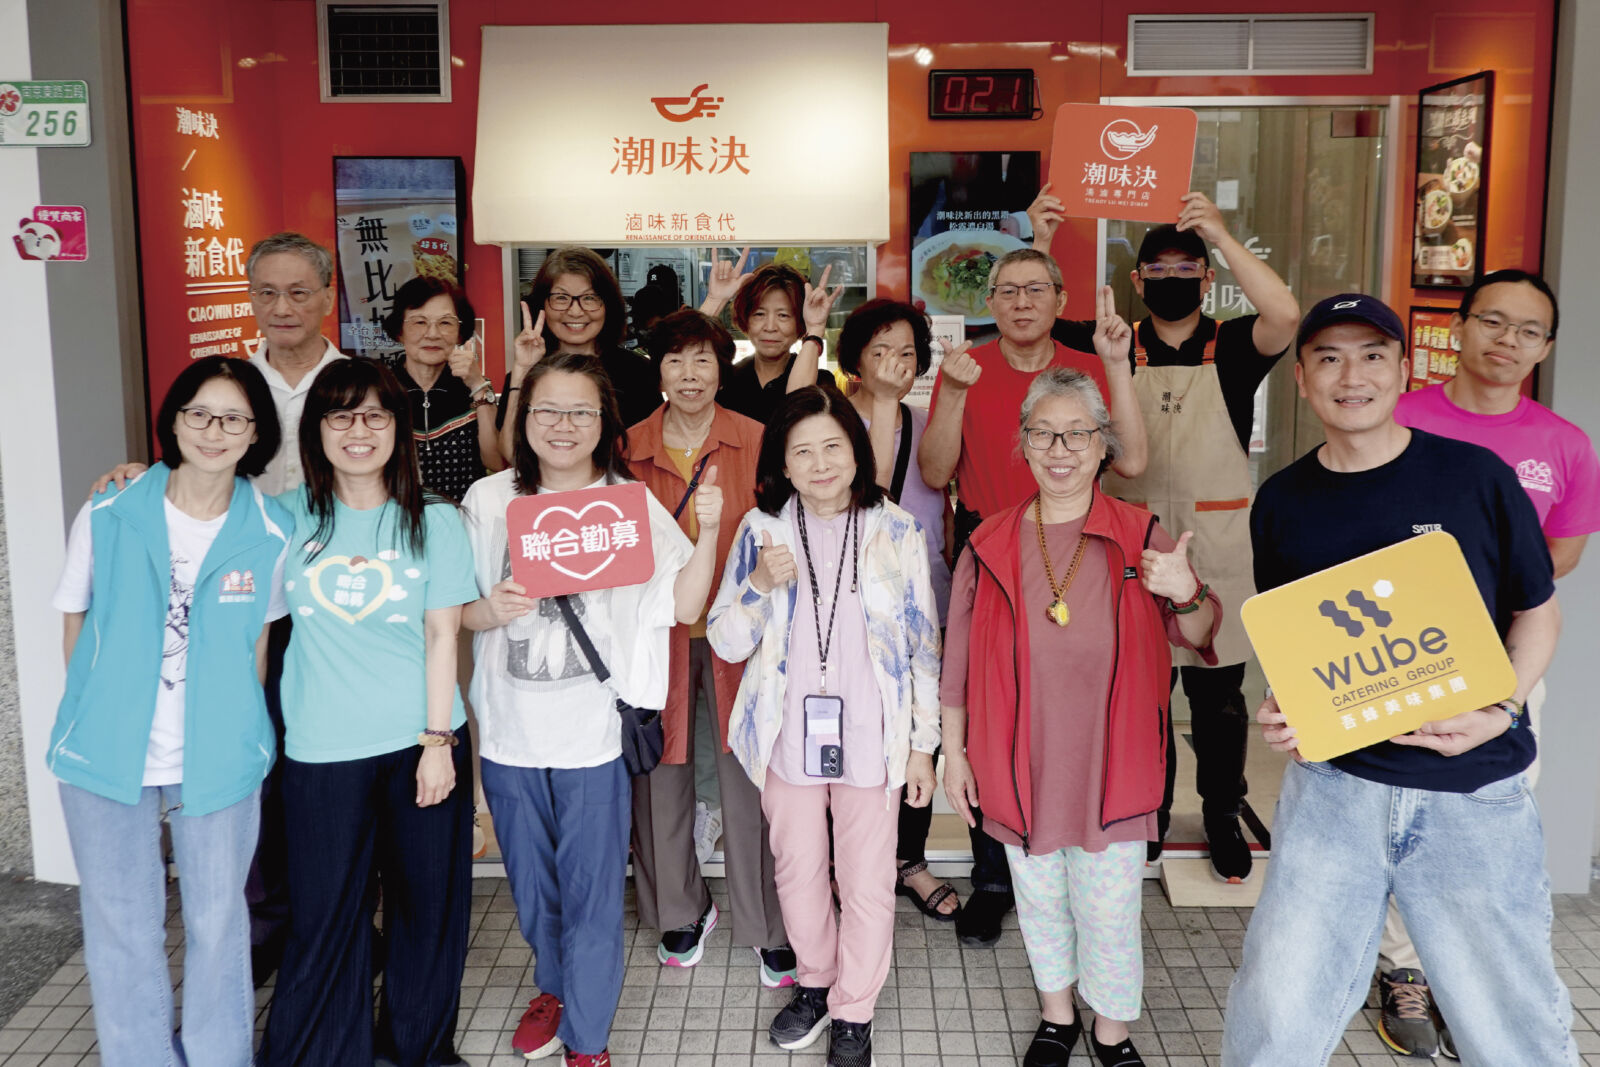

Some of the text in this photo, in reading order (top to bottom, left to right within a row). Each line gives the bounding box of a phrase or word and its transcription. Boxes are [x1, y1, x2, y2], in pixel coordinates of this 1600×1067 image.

[22, 85, 83, 98] 南京東路五段
[26, 110, 78, 136] 256
[176, 106, 219, 140] 潮味決
[610, 136, 750, 175] 潮味決
[1081, 162, 1157, 189] 潮味決
[182, 187, 225, 230] 滷味
[625, 212, 736, 232] 滷味新食代
[185, 236, 245, 278] 新食代
[188, 304, 233, 322] CIAOWIN
[520, 520, 640, 561] 聯合勸募
[1312, 627, 1448, 691] wube
[1331, 657, 1455, 707] CATERING GROUP
